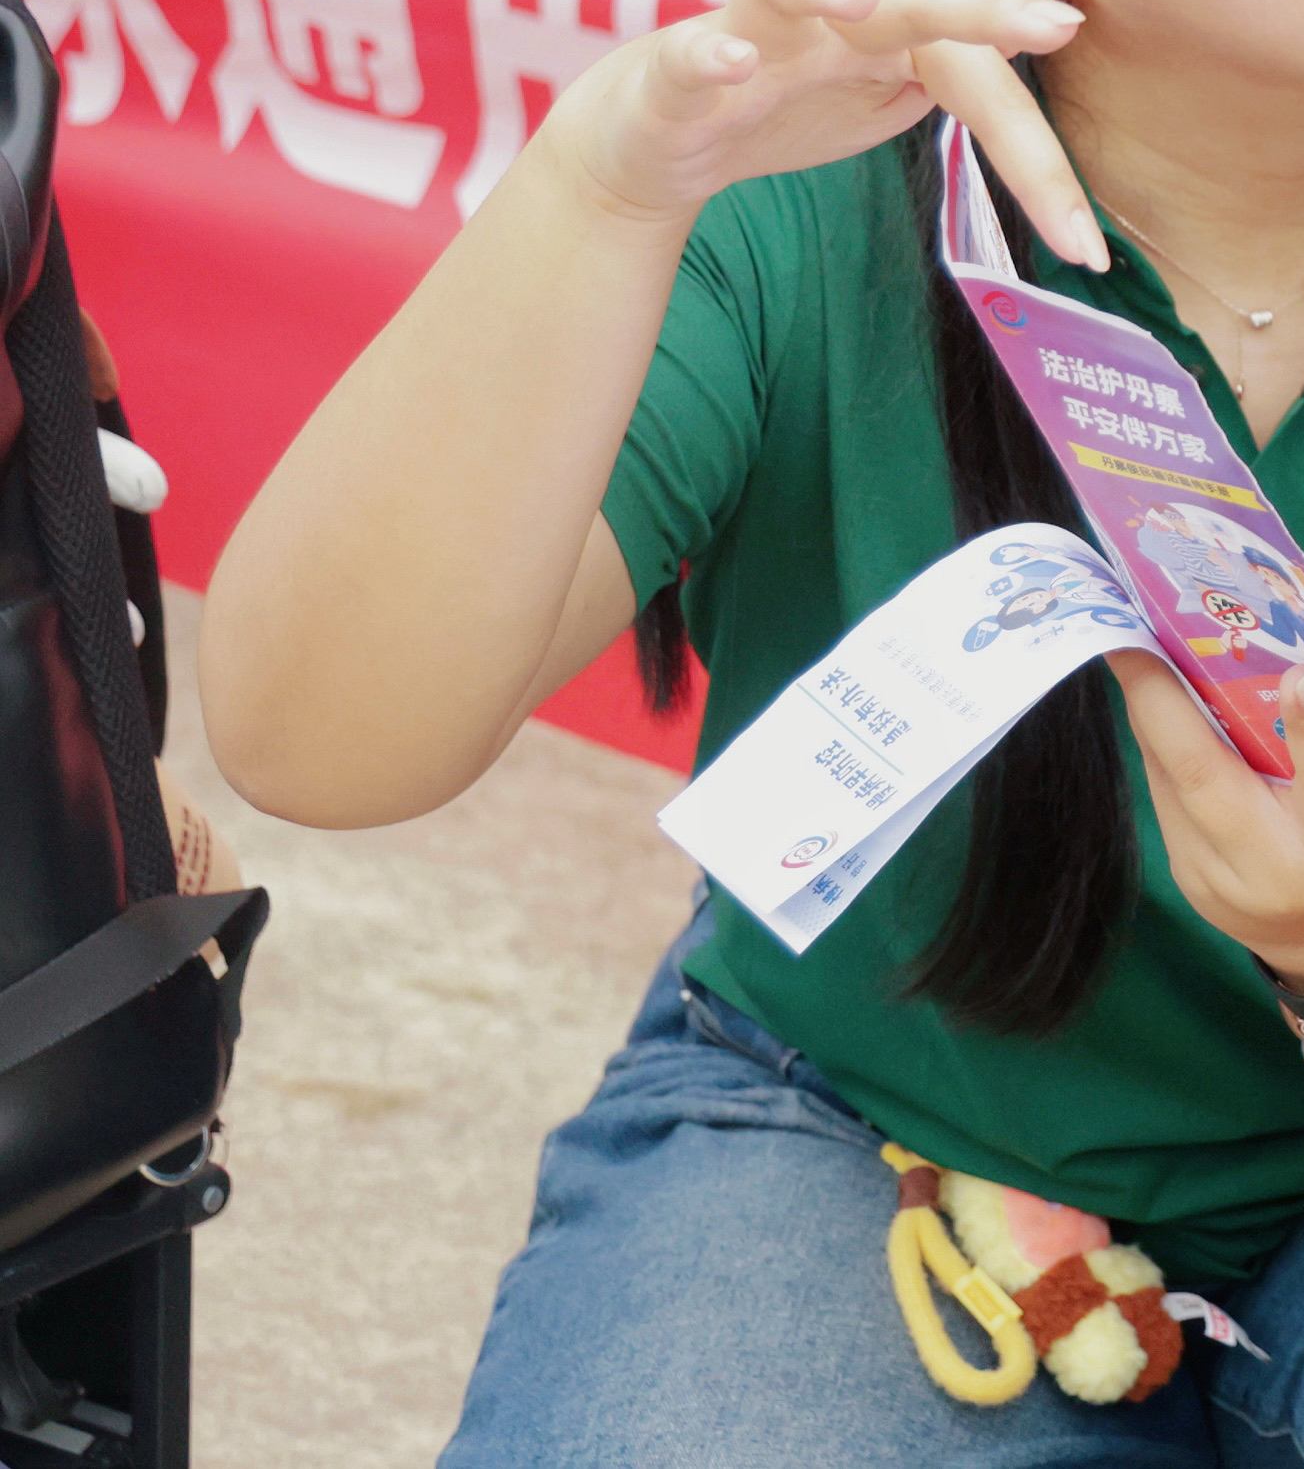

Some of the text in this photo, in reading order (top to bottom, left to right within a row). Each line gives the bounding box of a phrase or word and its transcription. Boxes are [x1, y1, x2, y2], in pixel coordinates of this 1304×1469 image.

[1038, 347, 1187, 419] 法治护丹寨
[1062, 395, 1214, 464] 平安伴万家
[818, 666, 913, 747] 急救有办法
[815, 739, 898, 811] 慢病早防控
